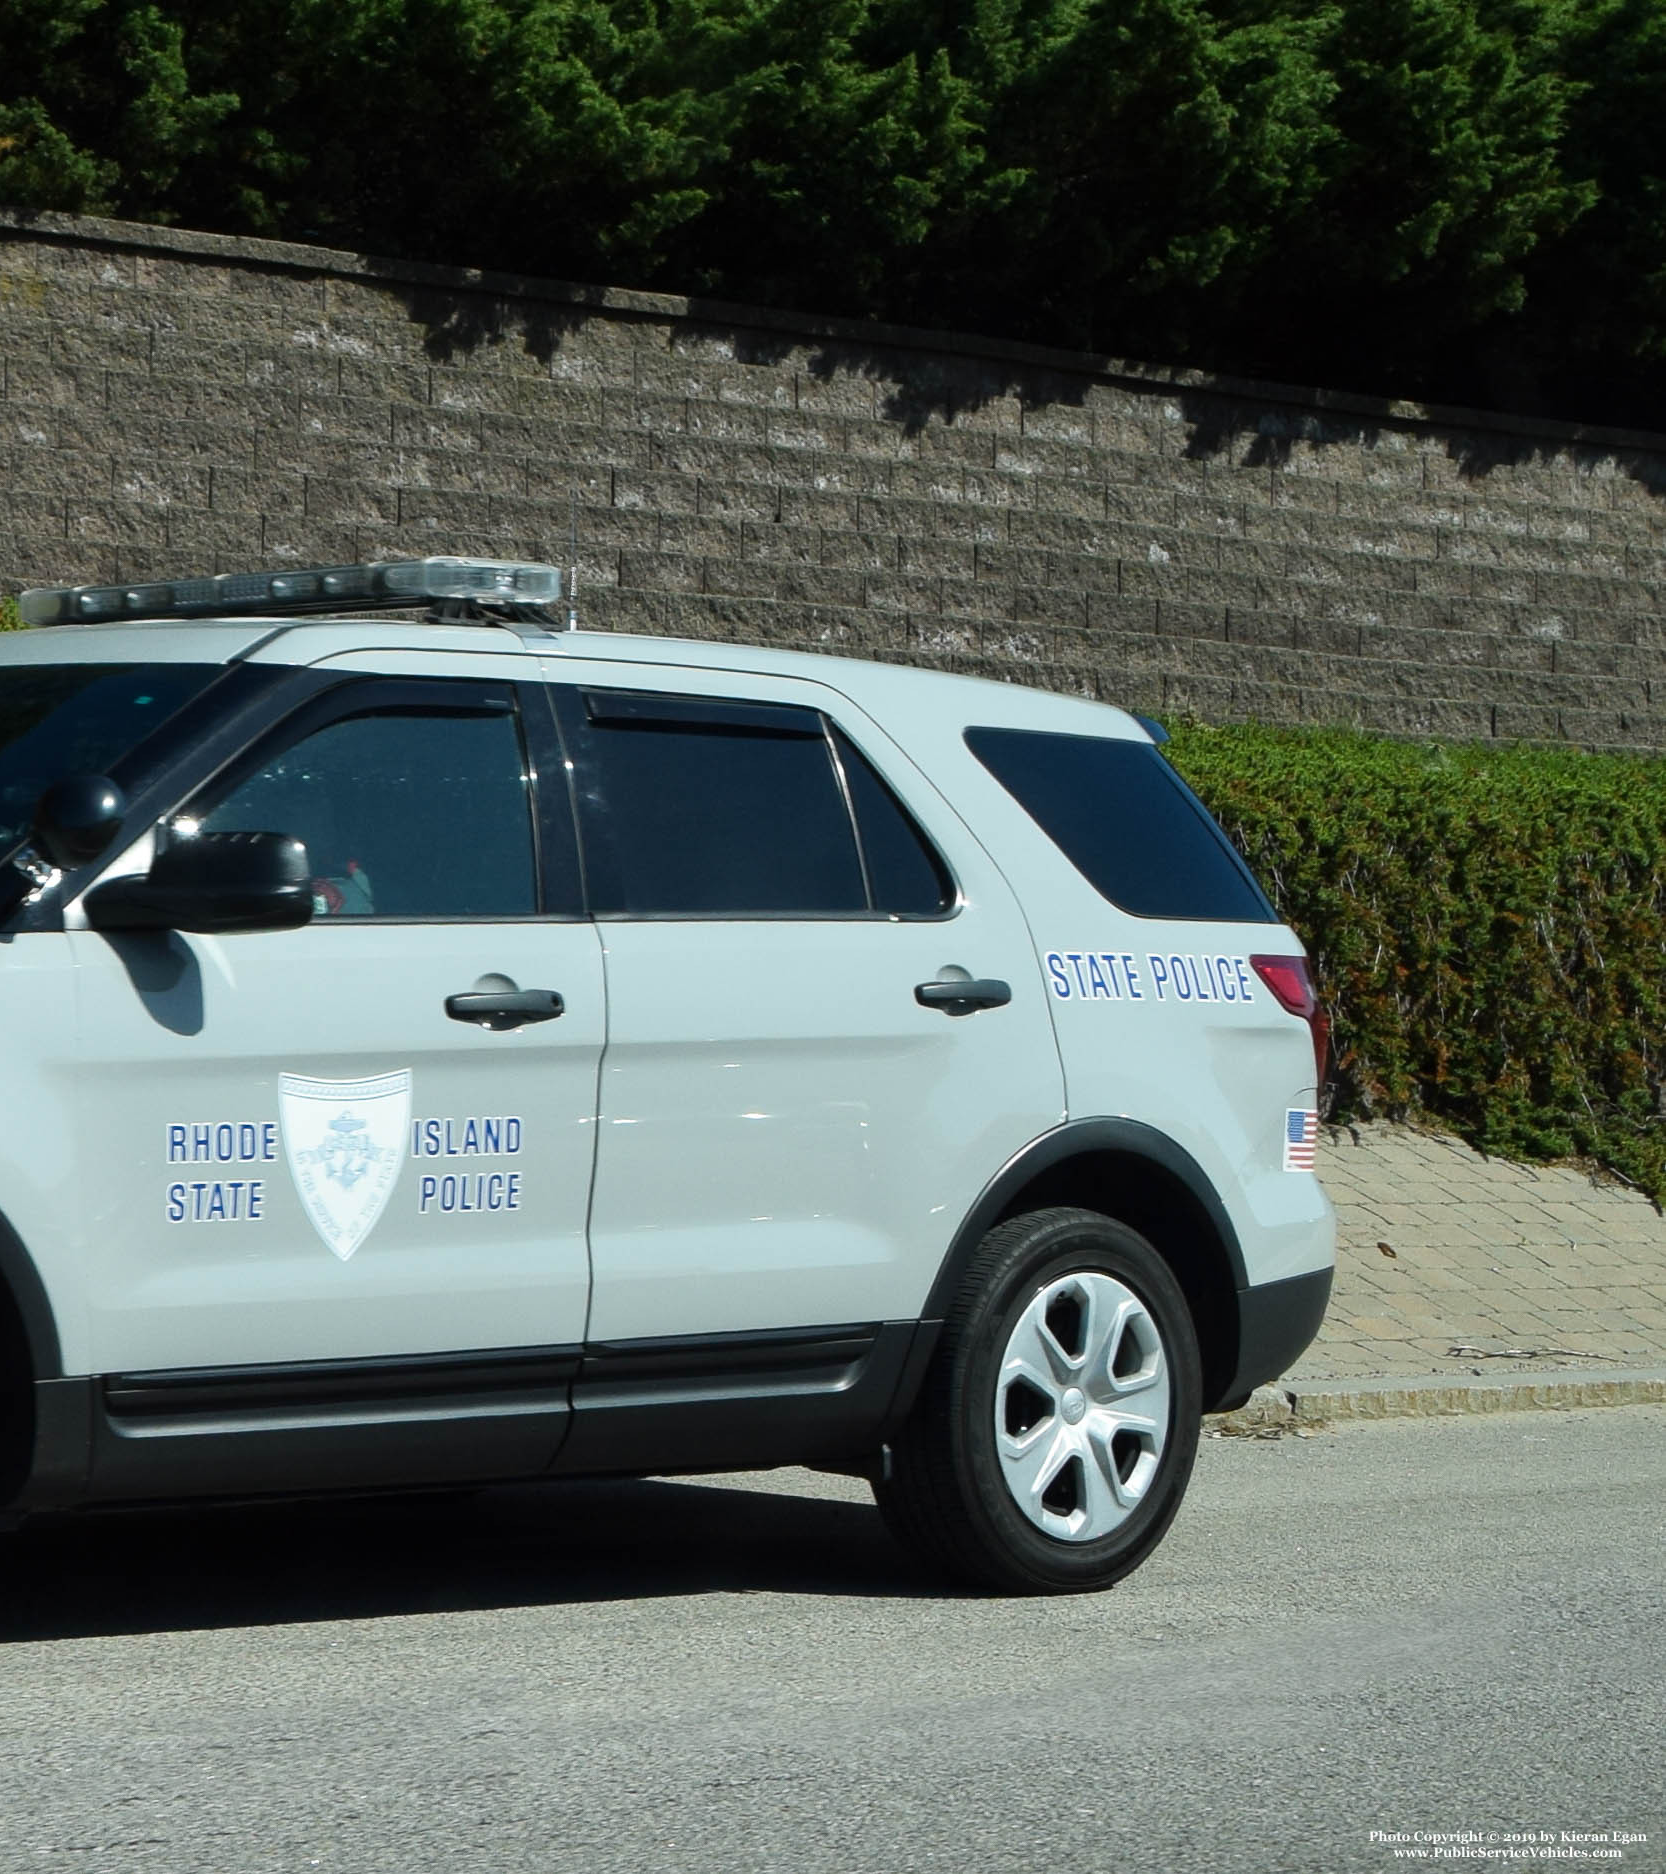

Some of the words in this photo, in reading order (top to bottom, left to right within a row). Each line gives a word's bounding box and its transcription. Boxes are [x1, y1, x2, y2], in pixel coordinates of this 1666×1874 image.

[1046, 952, 1143, 1000] STATE
[1148, 954, 1253, 1002] POLICE
[168, 1122, 276, 1162] RHODE
[413, 1117, 522, 1157] ISLAND
[168, 1181, 264, 1221] STATE
[421, 1173, 521, 1212] POLICE
